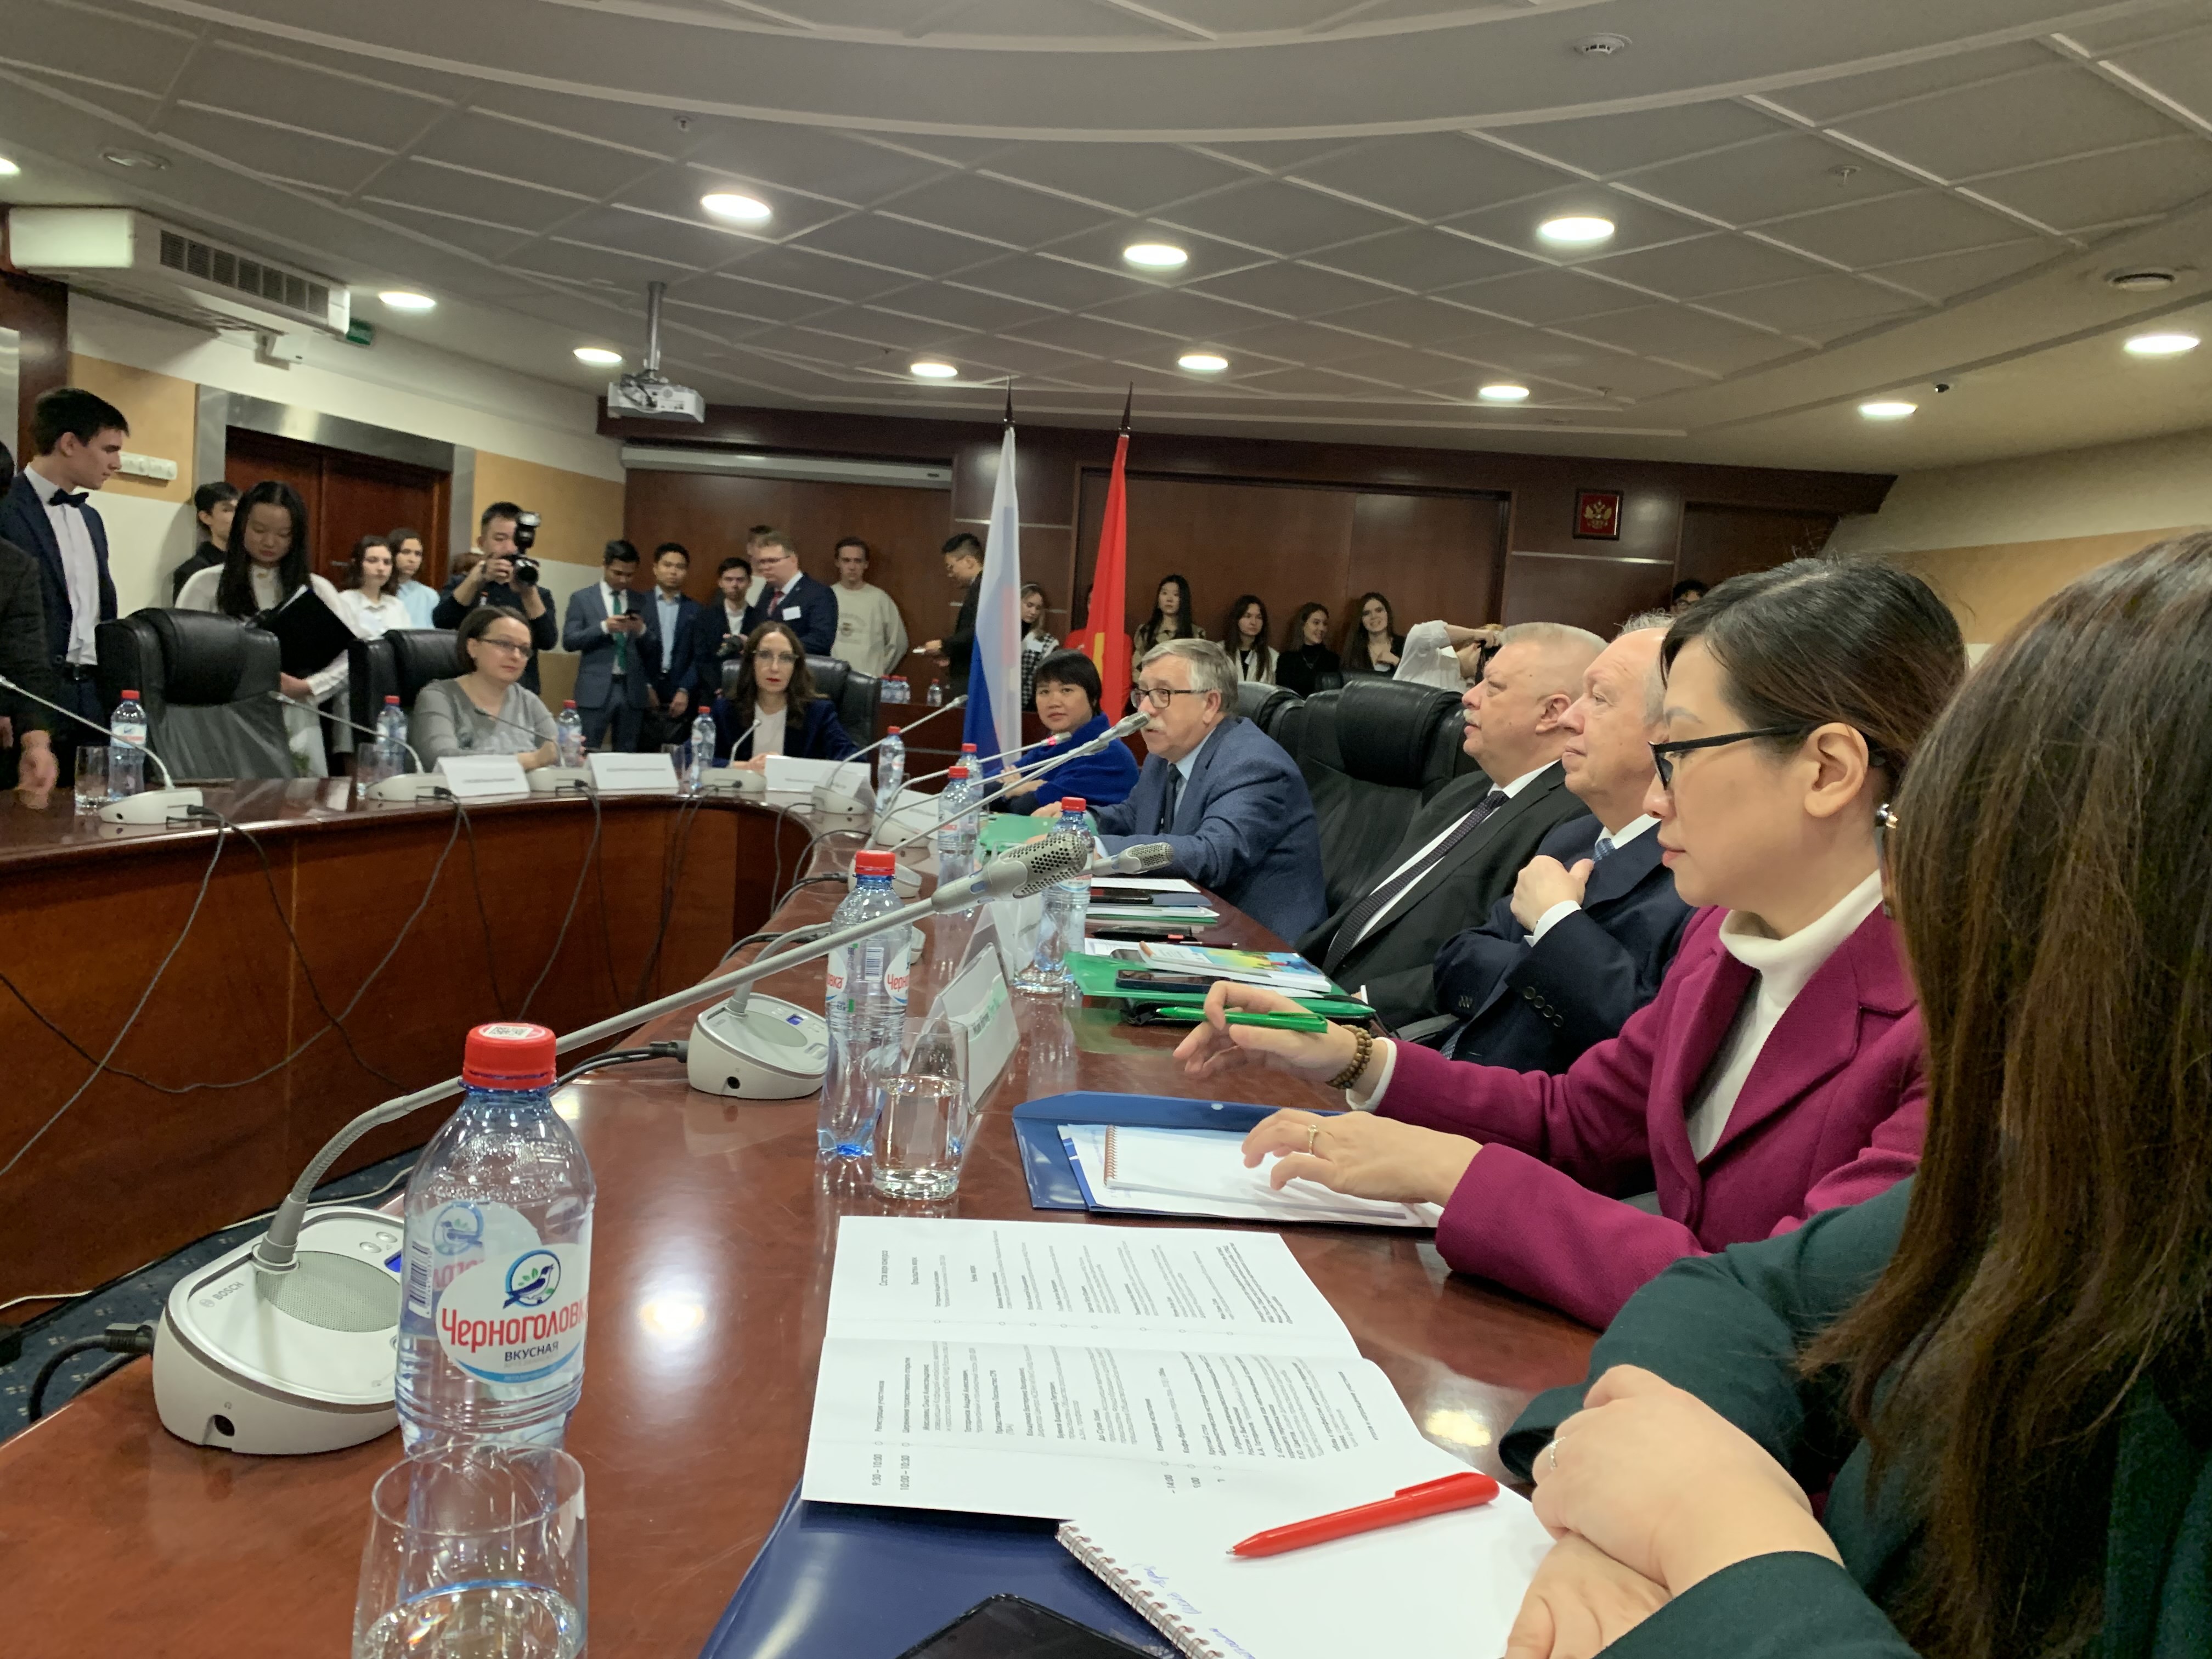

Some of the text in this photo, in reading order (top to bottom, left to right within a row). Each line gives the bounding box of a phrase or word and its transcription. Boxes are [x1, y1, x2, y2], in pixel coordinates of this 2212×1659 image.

[212, 1282, 244, 1300] BOSCH
[505, 1341, 558, 1361] ВКУСНАЯ
[873, 1454, 882, 1468] 10:00
[900, 1455, 910, 1469] 10:30
[872, 1474, 882, 1486] 9:30
[900, 1475, 910, 1490] 10:00
